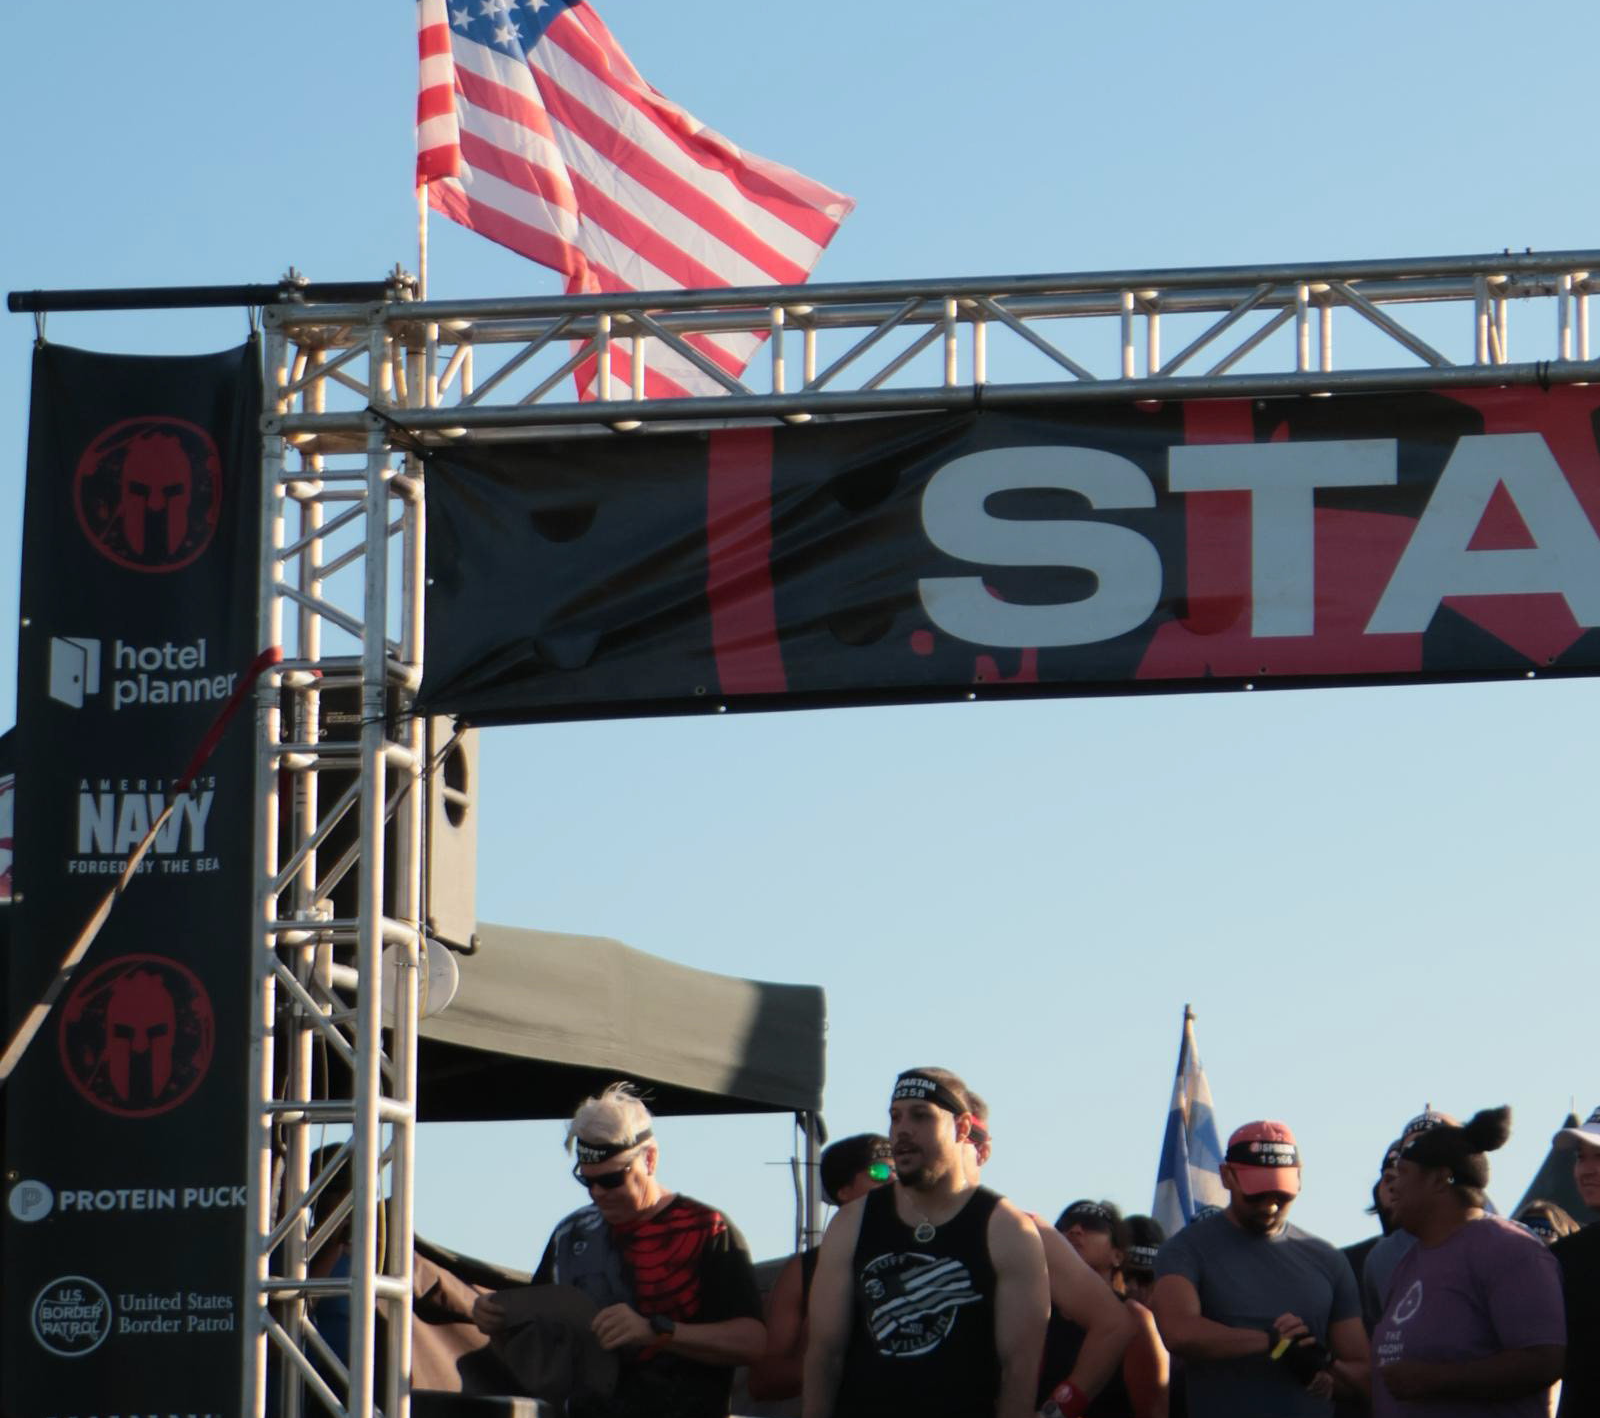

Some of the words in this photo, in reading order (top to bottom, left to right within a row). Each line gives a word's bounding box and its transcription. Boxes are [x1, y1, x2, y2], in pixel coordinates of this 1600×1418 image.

[114, 639, 207, 670] hotel
[113, 673, 238, 711] planner
[78, 791, 215, 854] NAVY
[68, 860, 129, 874] FORGED
[162, 859, 190, 873] THE
[195, 857, 220, 872] SEA
[59, 1188, 176, 1212] PROTEIN
[183, 1185, 247, 1209] PUCK
[119, 1292, 181, 1311] United
[187, 1292, 233, 1310] States
[42, 1306, 101, 1320] BORDER
[119, 1314, 181, 1334] Border
[187, 1313, 234, 1332] Patrol
[42, 1321, 101, 1336] PATROL
